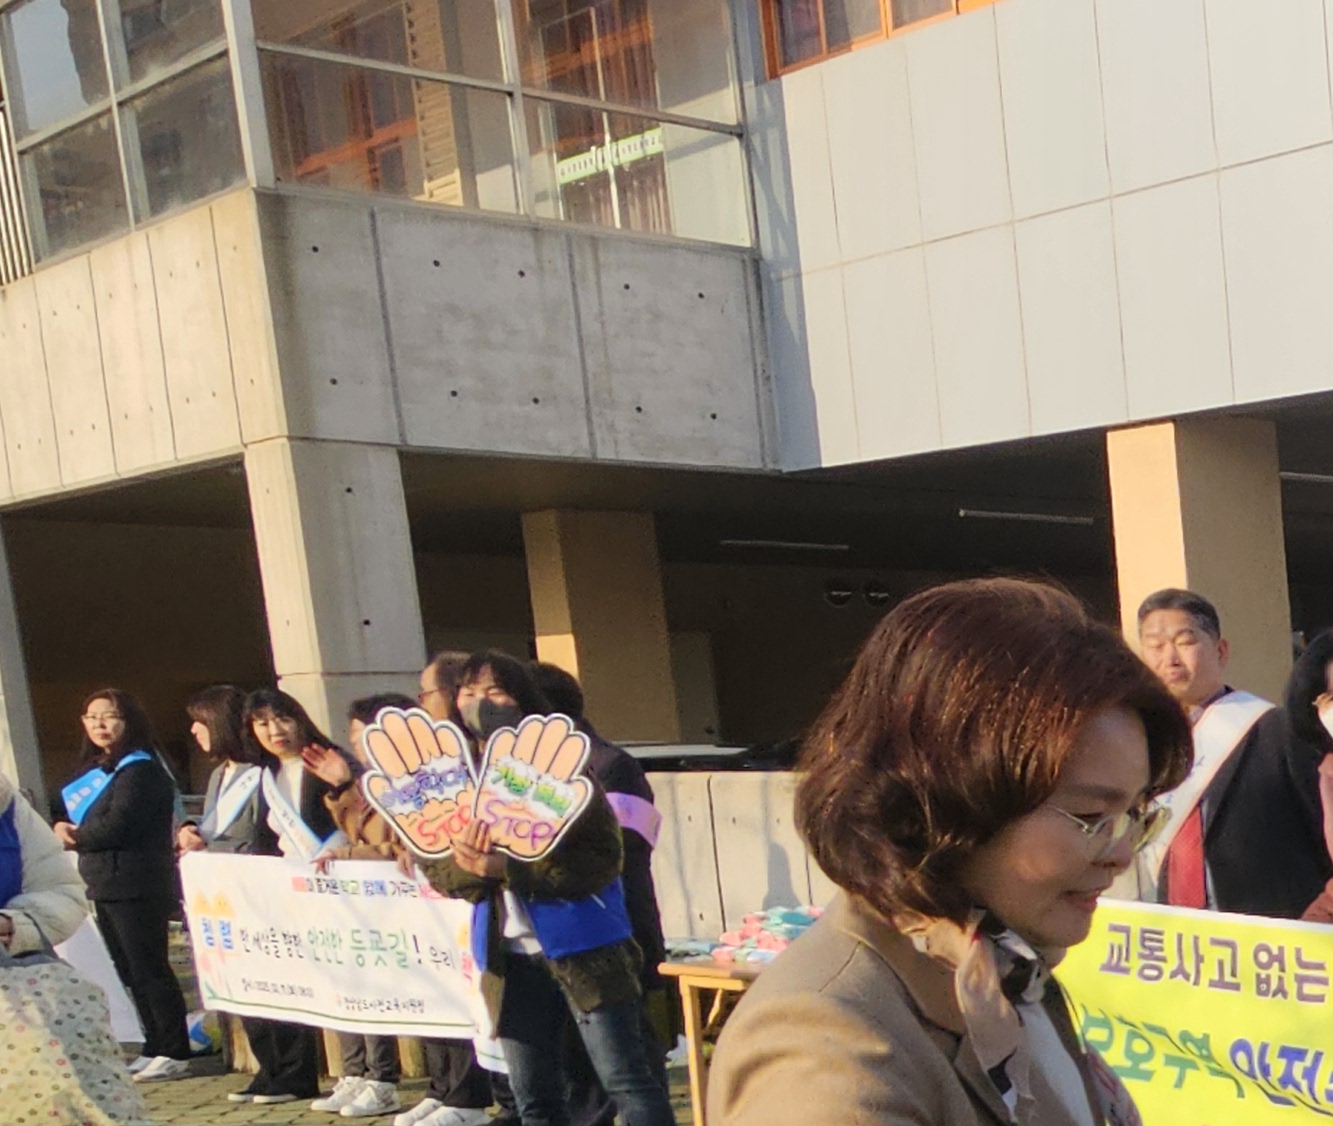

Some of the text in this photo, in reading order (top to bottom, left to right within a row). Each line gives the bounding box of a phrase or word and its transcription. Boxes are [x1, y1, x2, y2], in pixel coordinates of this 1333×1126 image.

[485, 800, 554, 850] STOP
[306, 926, 345, 965] 안전한
[429, 945, 456, 970] 우리
[1099, 922, 1242, 992] 교통사고
[1252, 942, 1331, 1005] 없는
